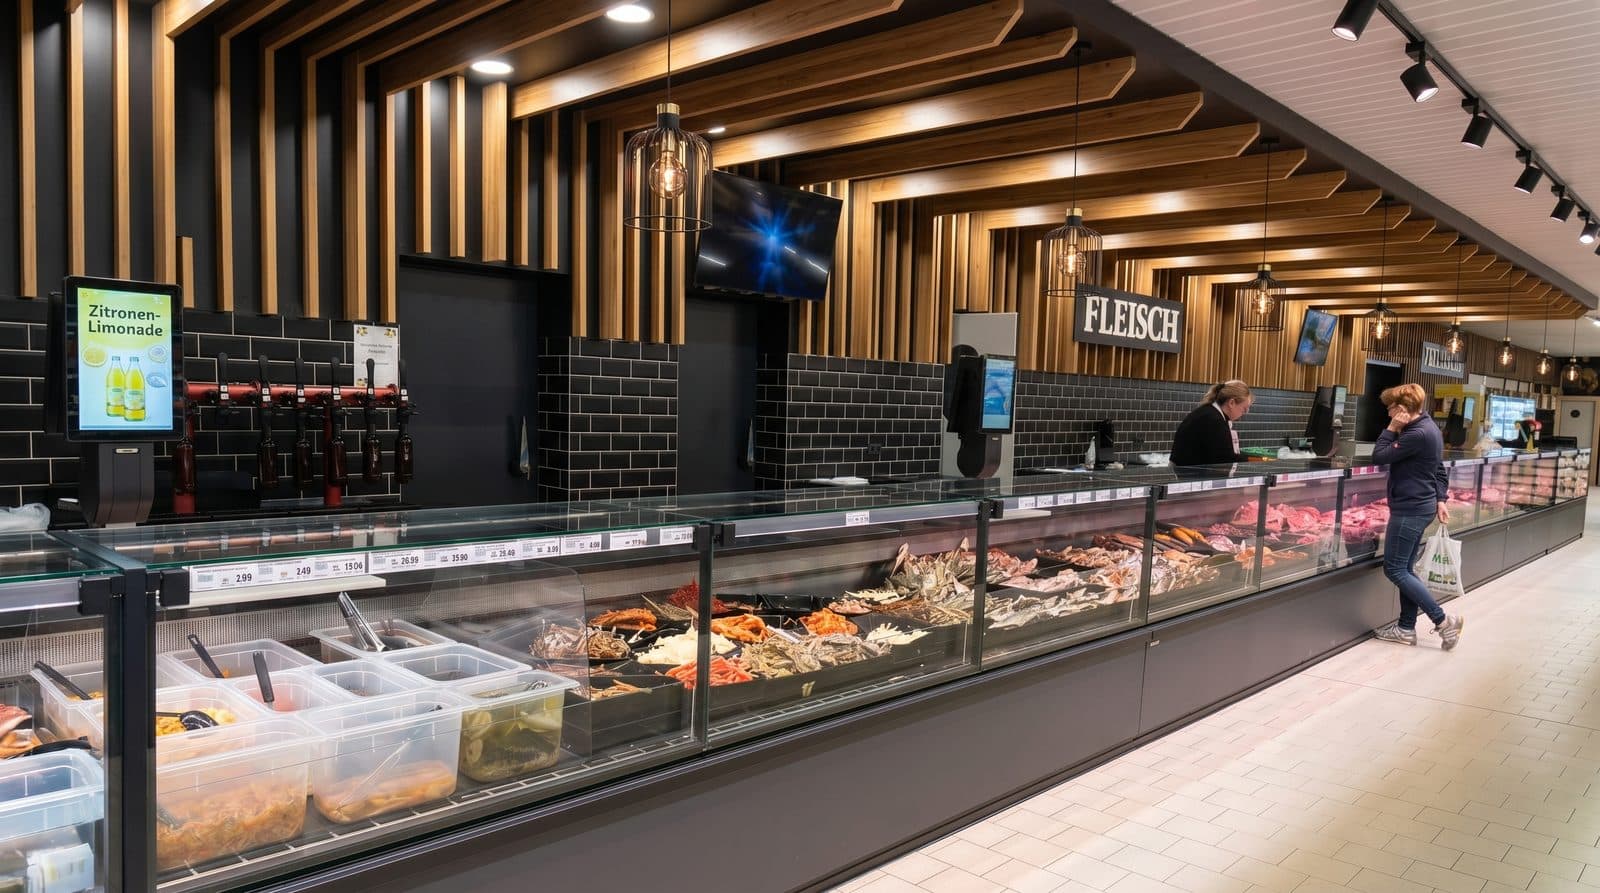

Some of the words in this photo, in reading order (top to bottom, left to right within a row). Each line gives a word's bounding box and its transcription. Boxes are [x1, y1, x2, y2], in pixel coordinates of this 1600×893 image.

[88, 304, 161, 321] Zitronen-
[1083, 294, 1180, 343] FLEISCH
[88, 320, 163, 336] Limonade
